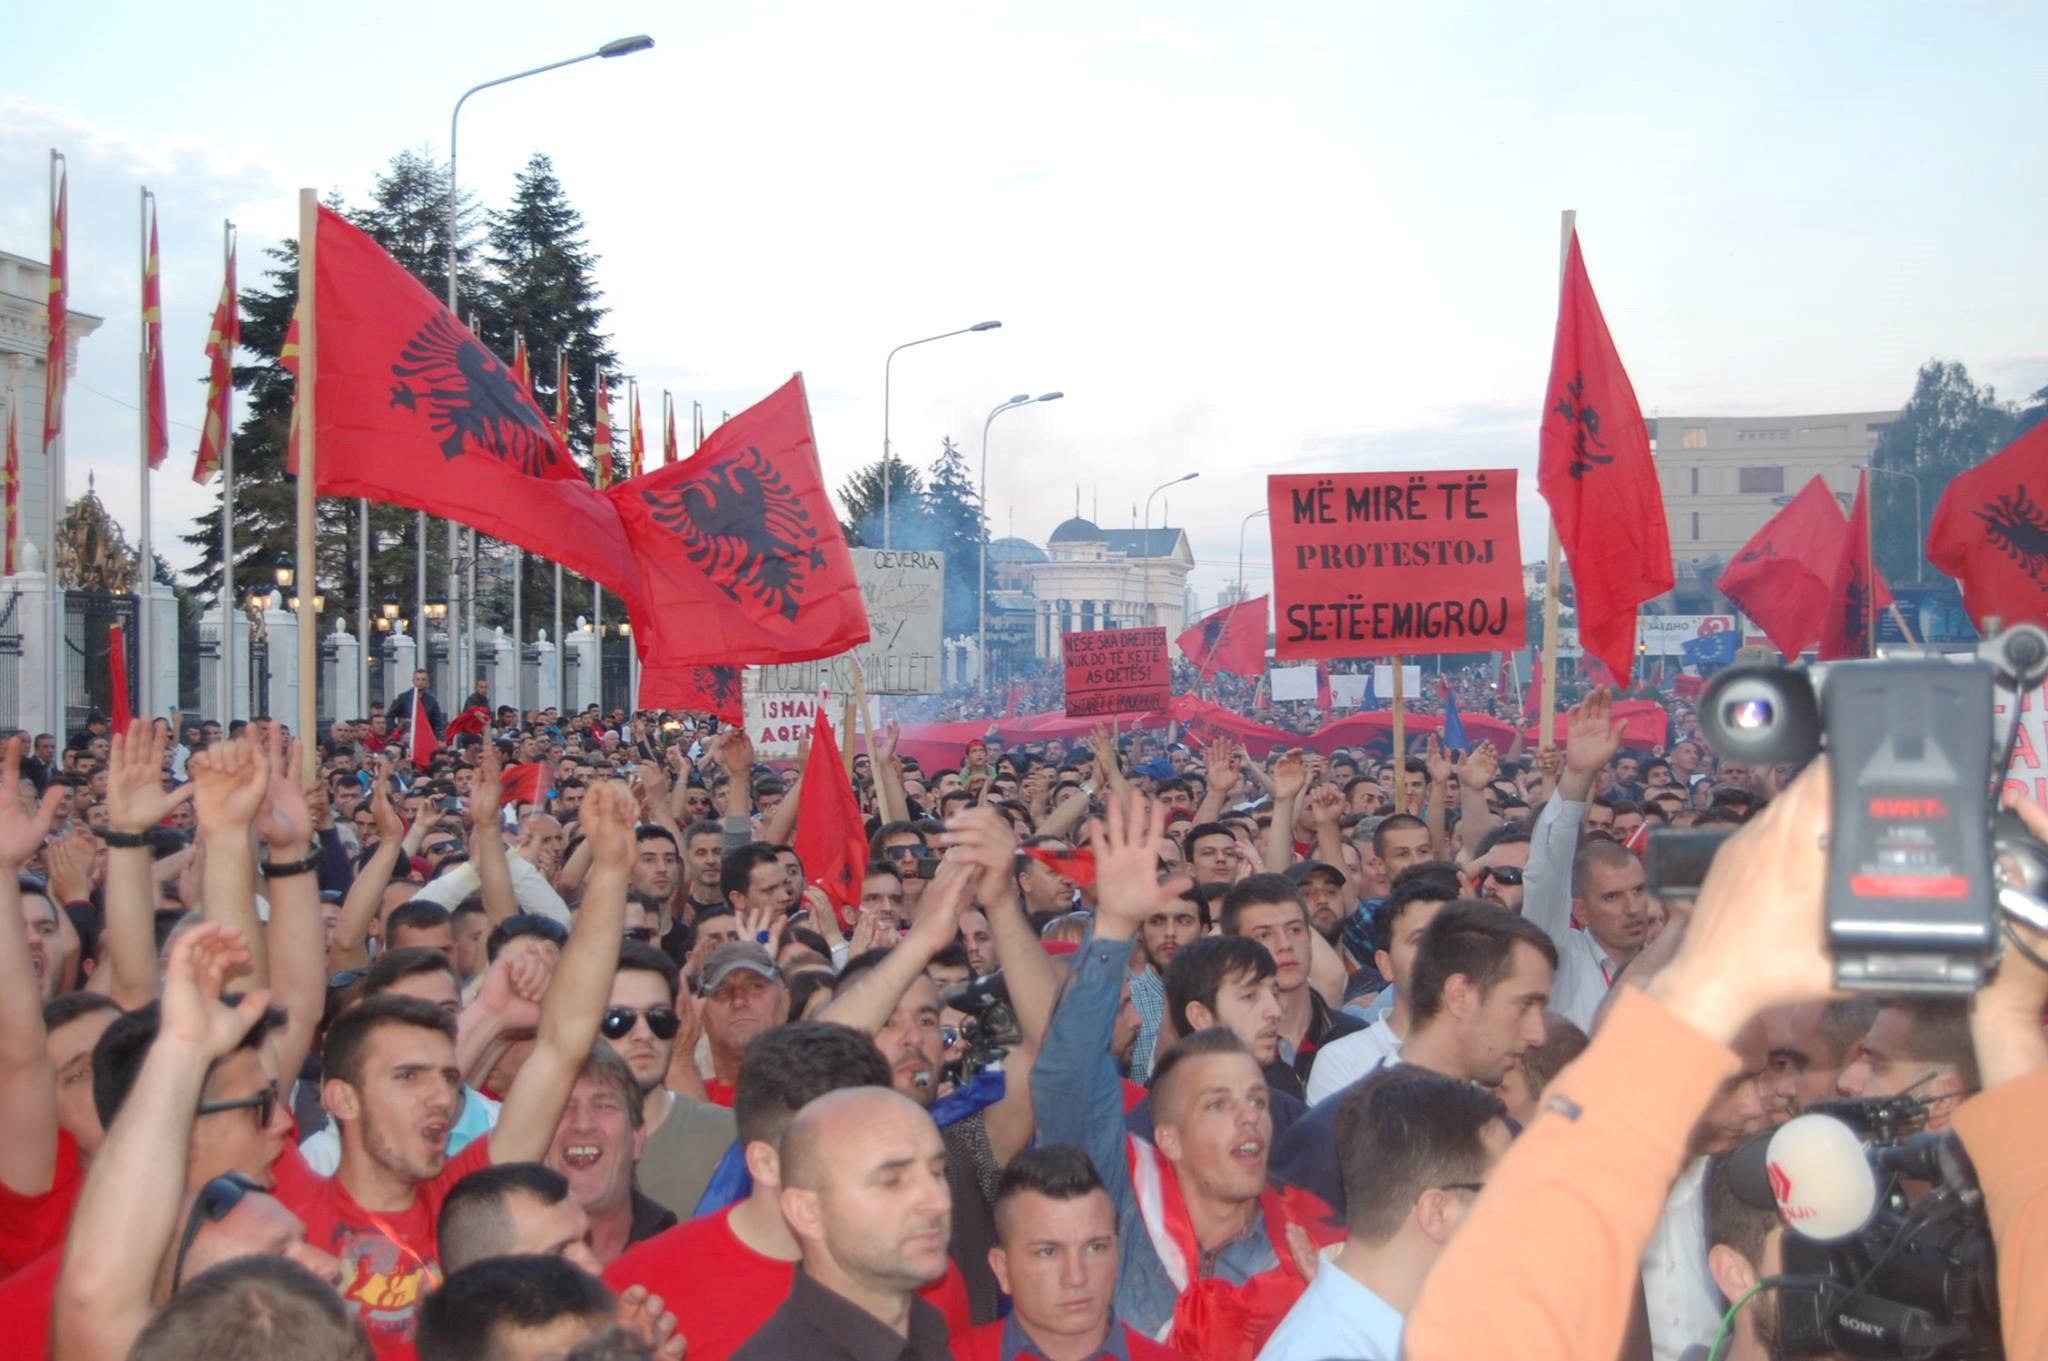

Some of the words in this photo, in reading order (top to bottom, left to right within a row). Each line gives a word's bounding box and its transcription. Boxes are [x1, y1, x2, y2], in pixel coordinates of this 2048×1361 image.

[1291, 480, 1337, 524] MË
[1346, 476, 1427, 522] MIRË
[1437, 474, 1488, 520] TË
[1295, 539, 1494, 570] PROTESTOJ
[1067, 655, 1088, 668] NUK
[1091, 652, 1106, 666] DO
[1086, 669, 1102, 684] AS
[762, 700, 828, 719] ISMAI
[1839, 1313, 1885, 1338] SONY
